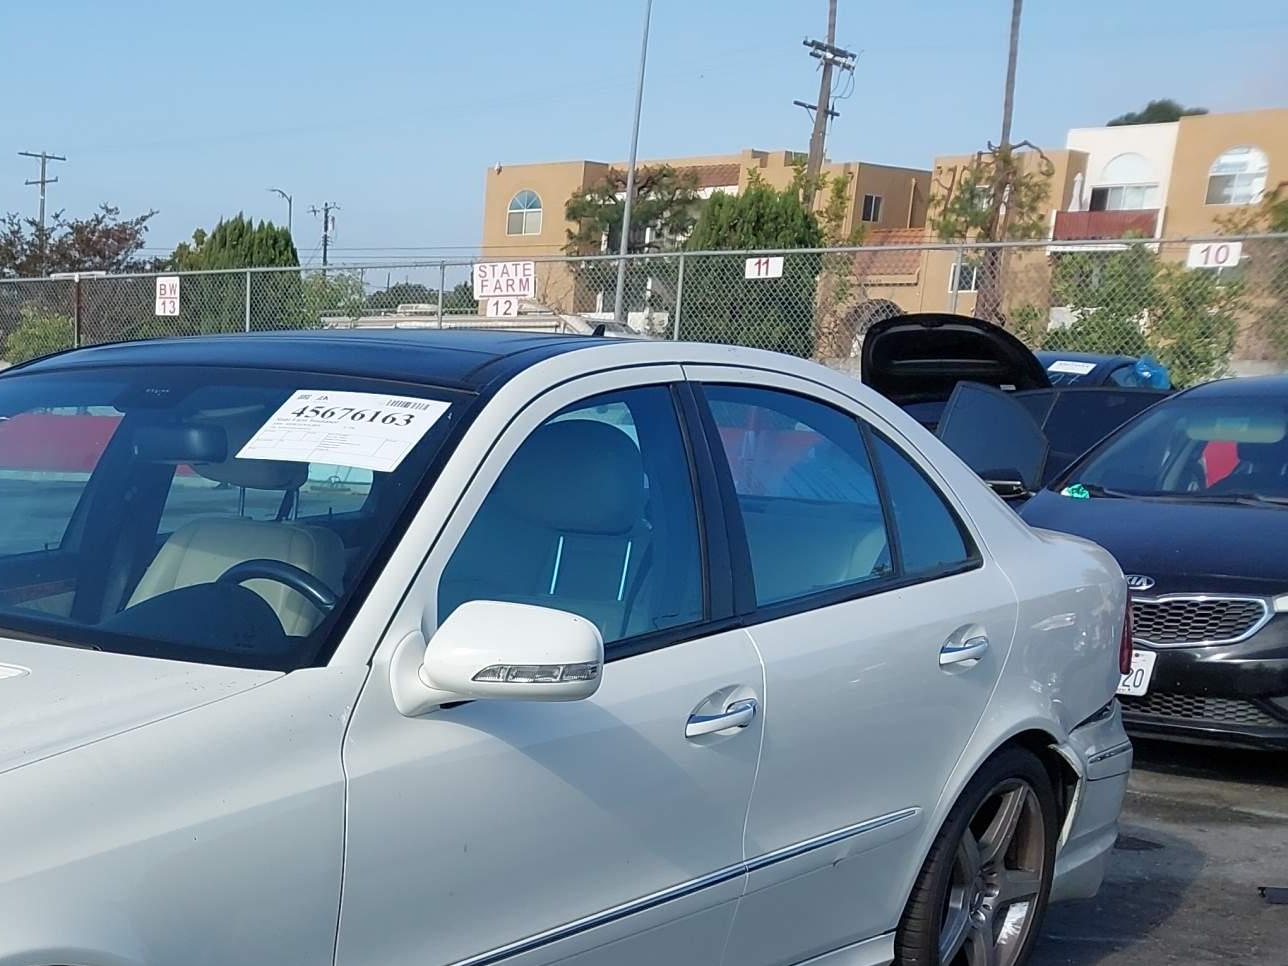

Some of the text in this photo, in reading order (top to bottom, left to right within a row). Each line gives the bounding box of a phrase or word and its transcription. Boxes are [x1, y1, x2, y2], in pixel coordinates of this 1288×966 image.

[1200, 244, 1230, 265] 10
[478, 262, 532, 279] STATE
[754, 257, 770, 277] 11
[159, 283, 178, 296] BW
[480, 277, 530, 294] FARM
[161, 300, 176, 314] 13
[492, 299, 513, 316] 12
[290, 405, 416, 427] 45676163
